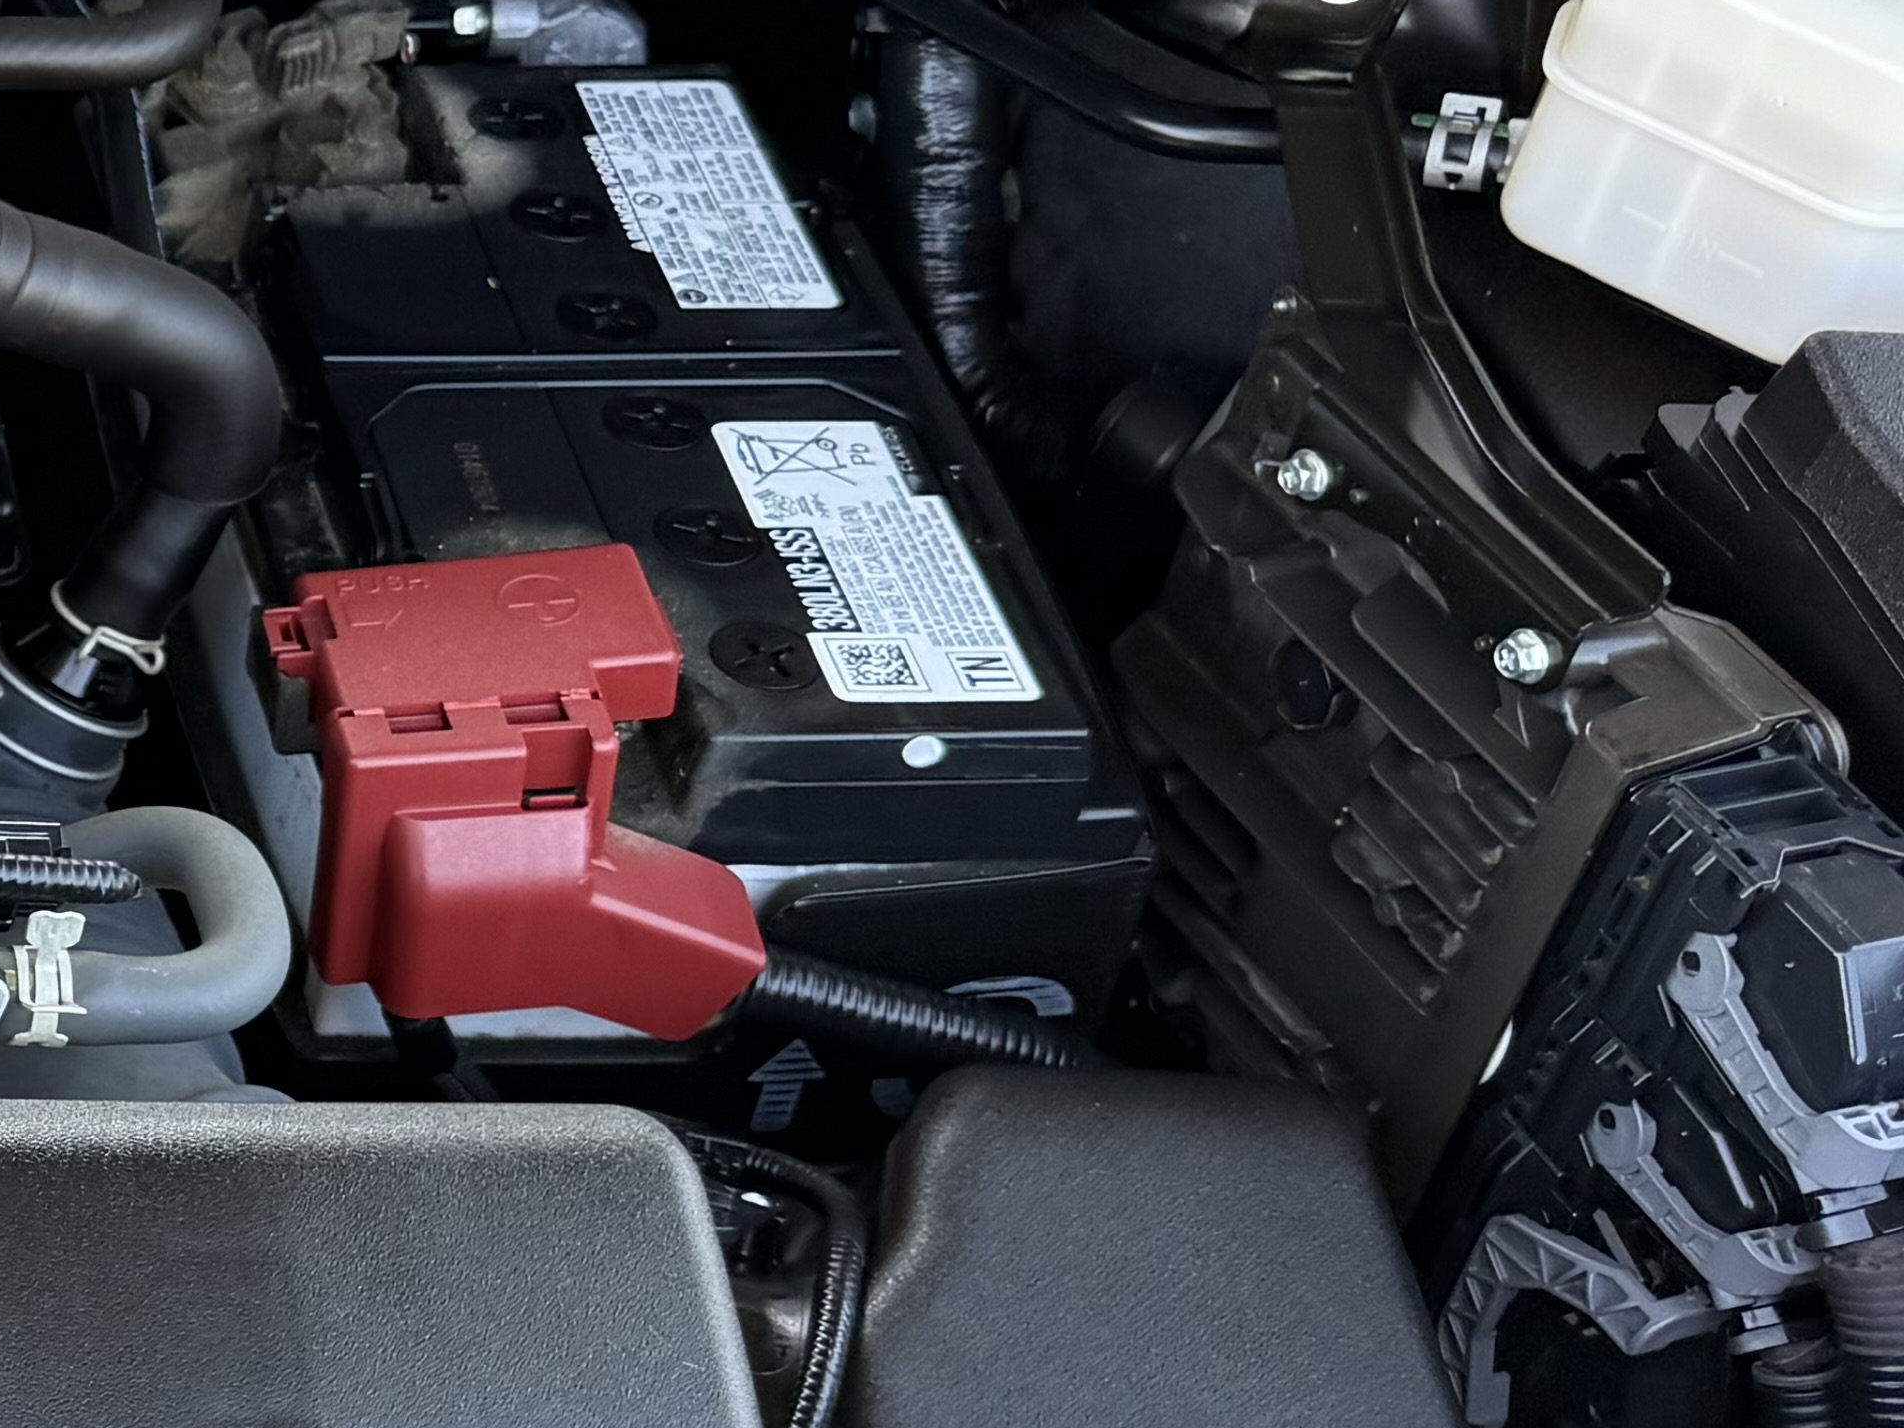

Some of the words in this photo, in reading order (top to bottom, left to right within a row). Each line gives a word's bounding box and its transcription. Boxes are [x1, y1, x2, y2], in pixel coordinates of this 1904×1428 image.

[843, 442, 879, 465] Pb
[766, 528, 859, 629] 380LN3-ISS
[954, 656, 1017, 687] TN
